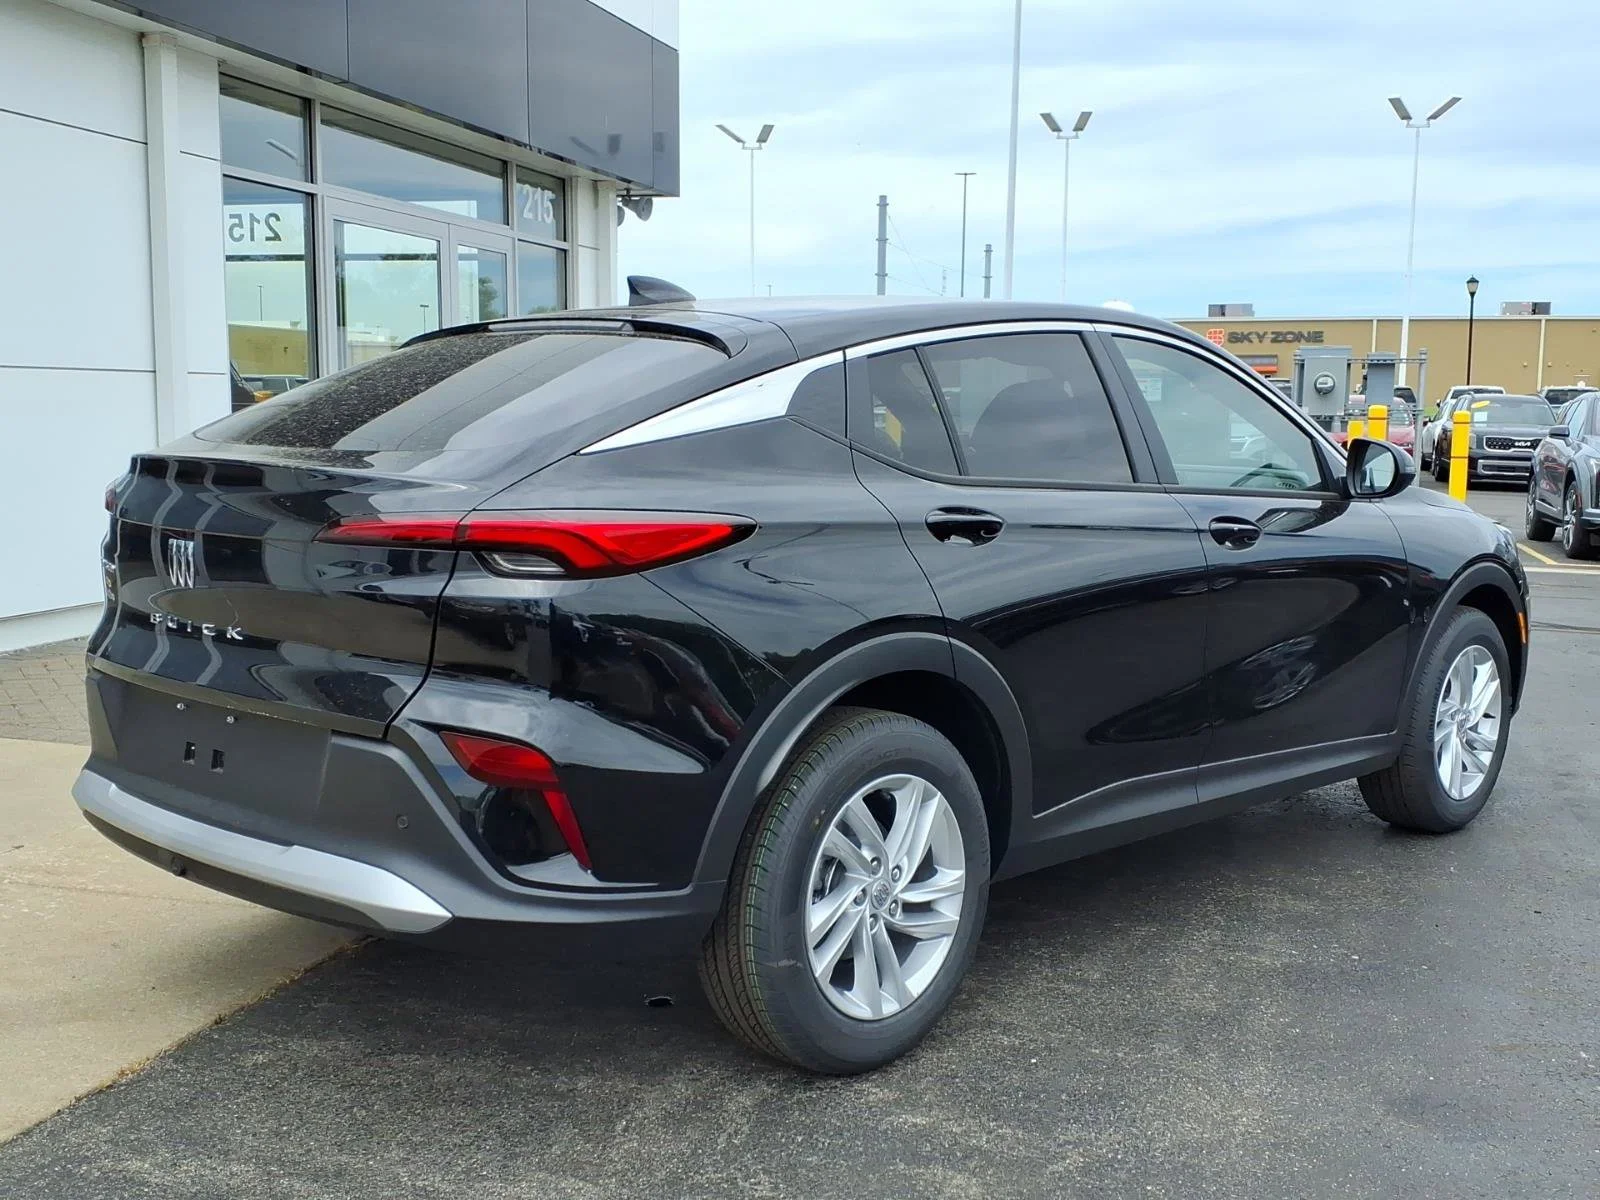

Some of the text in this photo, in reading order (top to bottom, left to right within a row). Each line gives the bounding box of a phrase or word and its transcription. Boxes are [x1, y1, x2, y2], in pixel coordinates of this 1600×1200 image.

[522, 184, 555, 224] 215
[1227, 330, 1324, 344] SKY ZONE
[150, 613, 243, 640] BUICK
